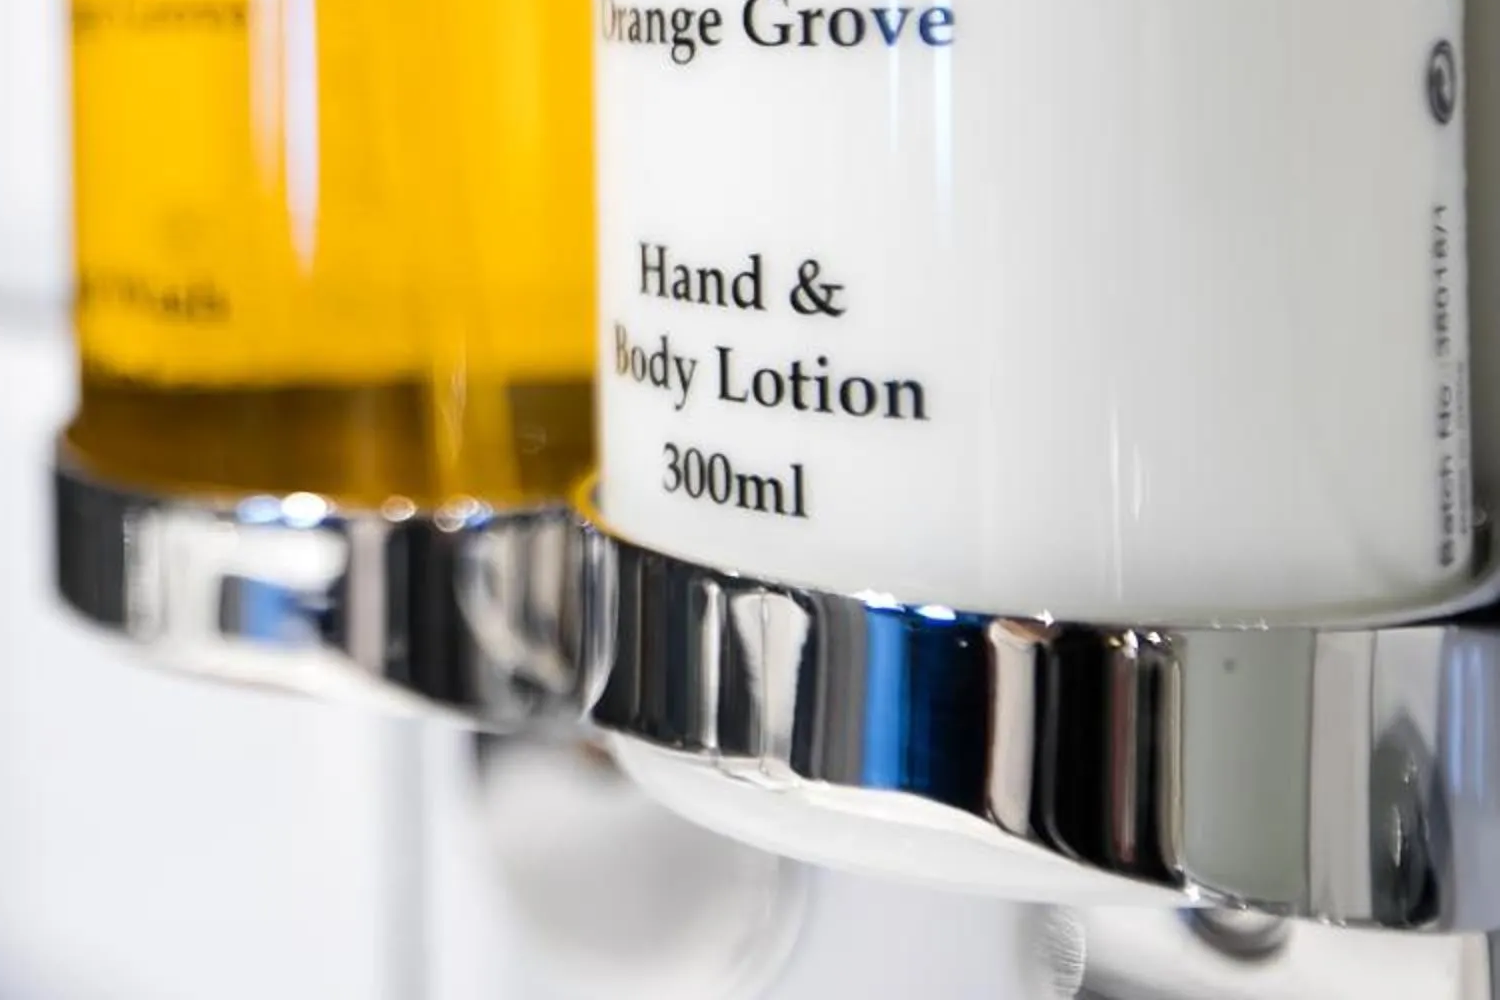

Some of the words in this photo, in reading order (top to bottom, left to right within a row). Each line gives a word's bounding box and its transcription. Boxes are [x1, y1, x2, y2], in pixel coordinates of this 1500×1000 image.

[638, 240, 766, 310] Hand
[789, 258, 847, 318] &
[614, 320, 698, 411] Body
[715, 344, 931, 422] Lotion
[662, 441, 811, 519] 300ml
[1437, 452, 1455, 568] Batch
